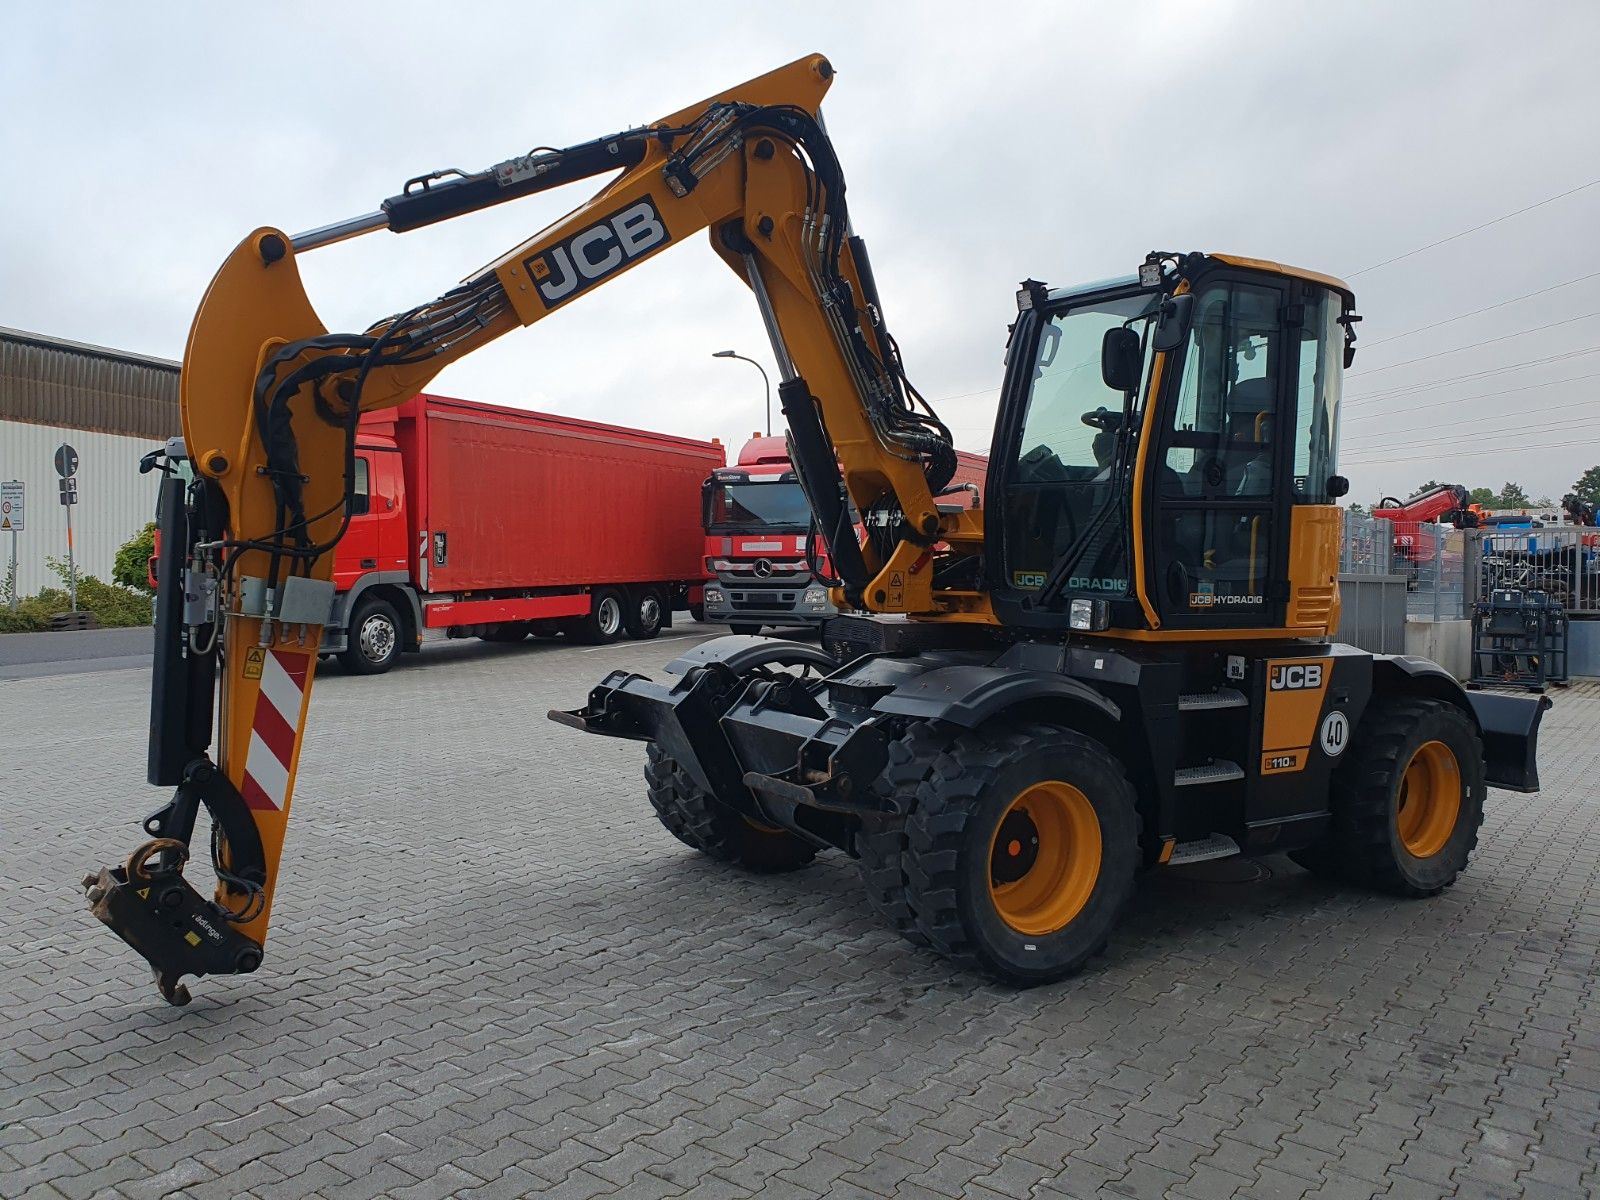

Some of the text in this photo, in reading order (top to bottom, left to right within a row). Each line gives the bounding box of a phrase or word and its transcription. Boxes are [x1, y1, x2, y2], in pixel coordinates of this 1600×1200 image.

[540, 202, 664, 300] JCB
[1017, 574, 1128, 590] JCB DRADIG
[1191, 595, 1263, 604] JCB HYDRADIG
[1271, 665, 1322, 690] JCB
[1326, 721, 1343, 747] 40
